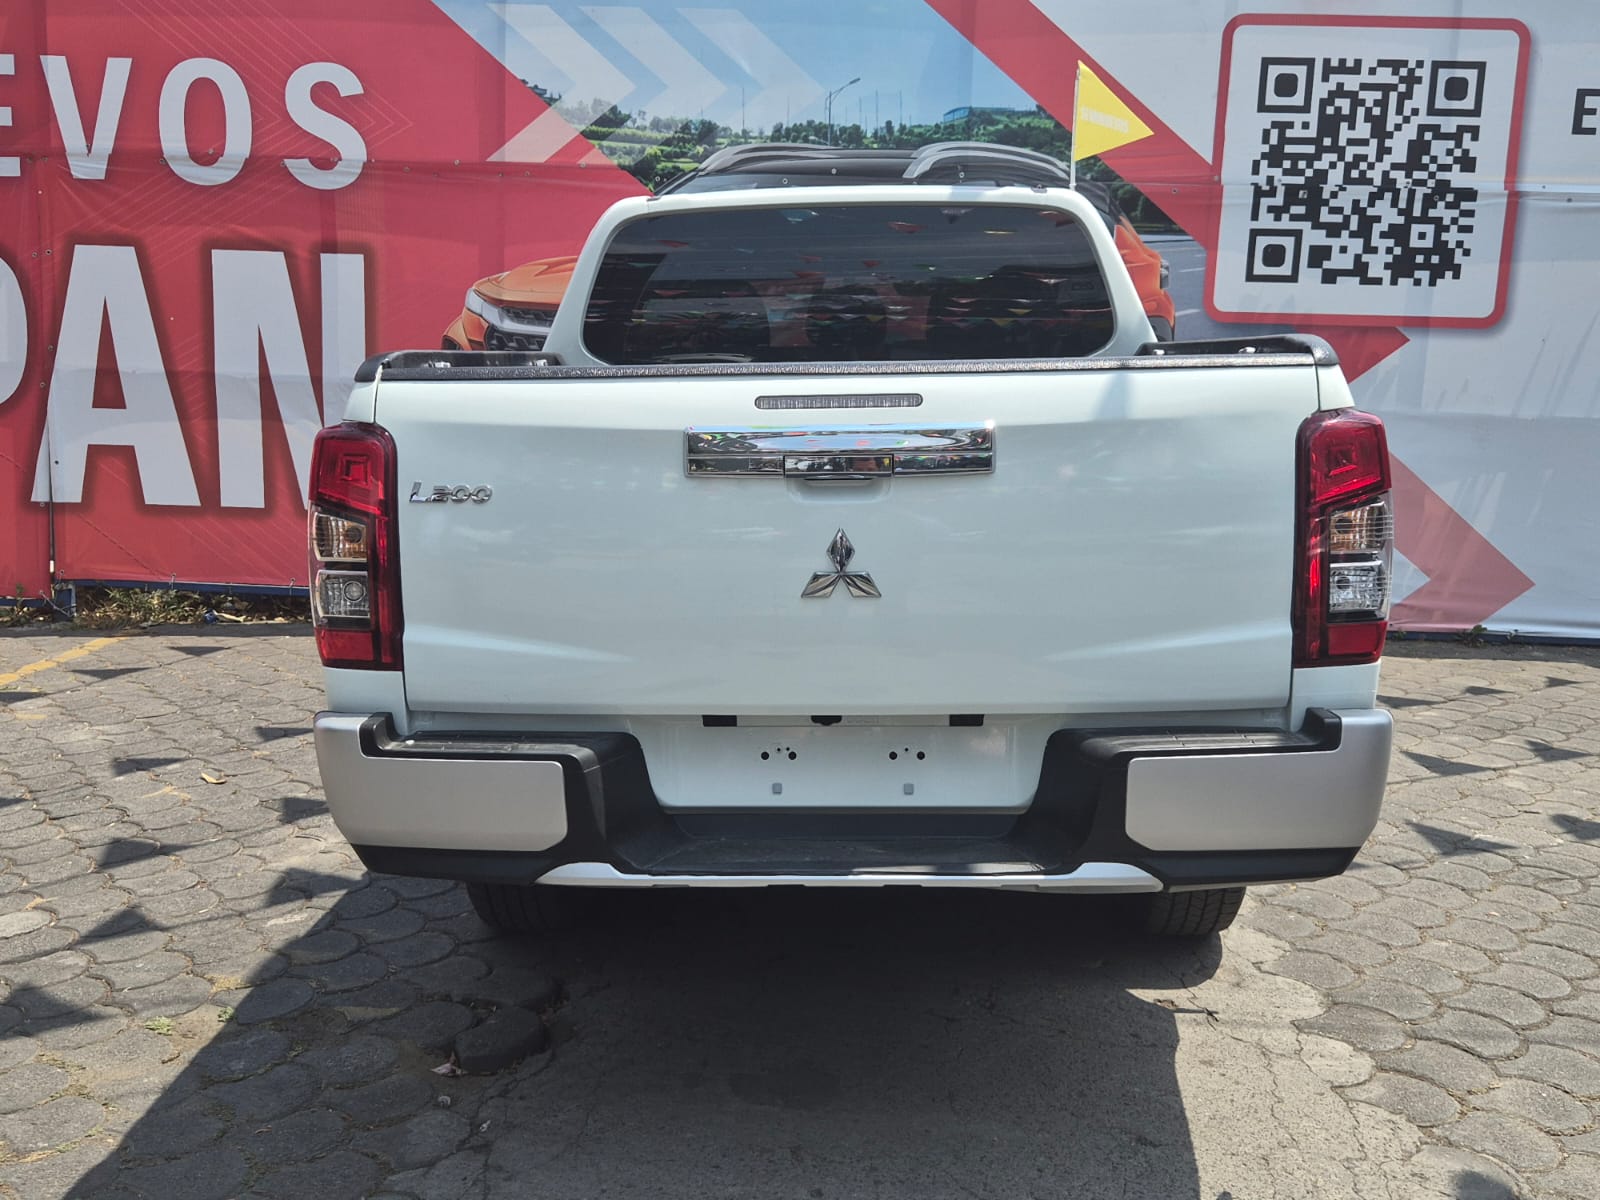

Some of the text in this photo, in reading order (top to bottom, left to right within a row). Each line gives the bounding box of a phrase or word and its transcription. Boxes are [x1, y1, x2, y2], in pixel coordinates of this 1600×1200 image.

[0, 54, 367, 190] VOS
[0, 244, 366, 509] AN
[409, 482, 493, 504] L200
